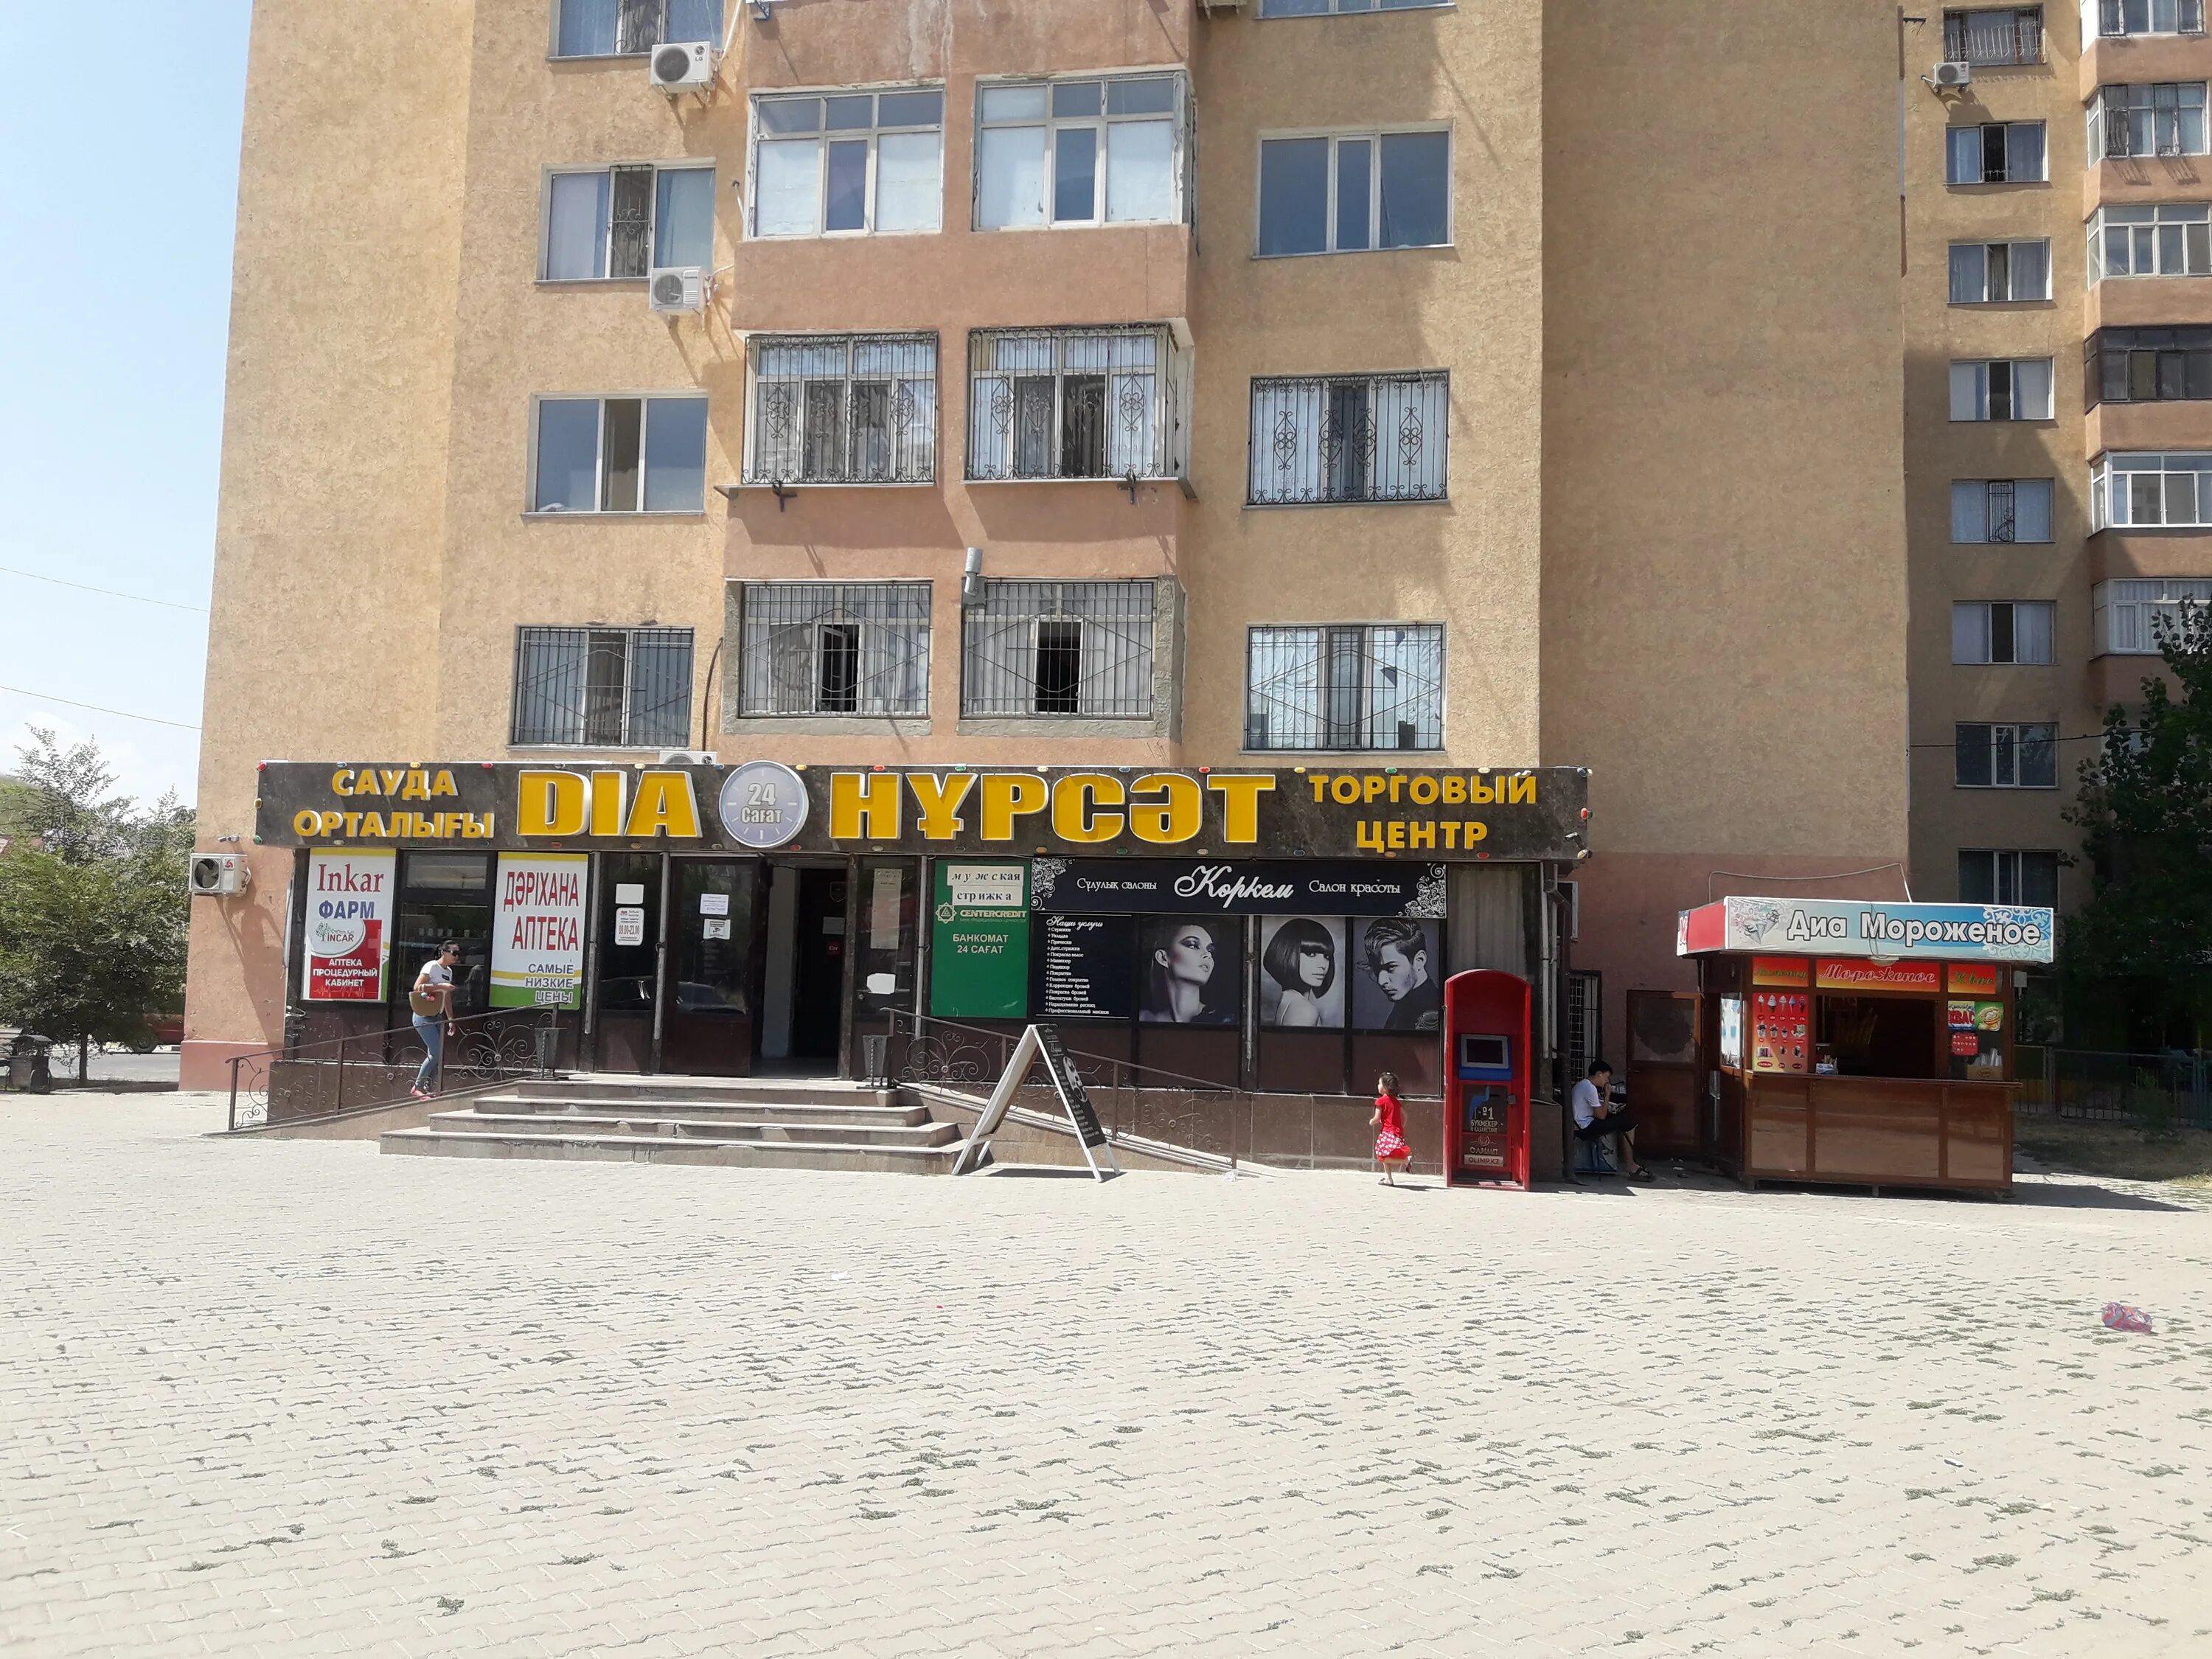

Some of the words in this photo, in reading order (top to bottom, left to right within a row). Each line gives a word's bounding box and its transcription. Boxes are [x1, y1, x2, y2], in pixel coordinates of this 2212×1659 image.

[331, 769, 459, 801] САУДА
[1309, 772, 1537, 805] ТОРГОВЫЙ
[517, 770, 703, 837] DIA
[748, 782, 777, 807] 24
[740, 806, 783, 824] Сағат
[830, 772, 1276, 844] НҰРСӘТ
[293, 810, 495, 838] ОРТАЛЫҒЫ
[1356, 821, 1488, 853] ЦЕНТР
[316, 863, 384, 893] Inkar
[1121, 881, 1158, 890] салоны
[503, 871, 579, 912] ДӘРІХАНА
[1309, 880, 1346, 893] Салон
[1350, 883, 1401, 897] красоты
[319, 900, 375, 919] ФАРМ
[960, 909, 1027, 918] CENTERCREDIT
[1046, 915, 1077, 928] Наши
[1787, 909, 1848, 942] Диа
[1860, 911, 2042, 947] Мороженое
[512, 916, 579, 951] АПТЕКА
[953, 933, 1009, 943] БАНКОМАТ
[957, 945, 968, 953] 24
[971, 945, 1004, 954] САҒАТ
[329, 959, 363, 967] АПТЕКА
[528, 963, 574, 975] САМЫЕ
[313, 967, 378, 978] ПРОЦЕДУРНЫЙ
[1820, 964, 1936, 984] Мороженое
[324, 978, 365, 987] КАБИНЕТ
[526, 978, 574, 989] НИЗКИЕ
[535, 991, 573, 1004] ЦЕНЫ
